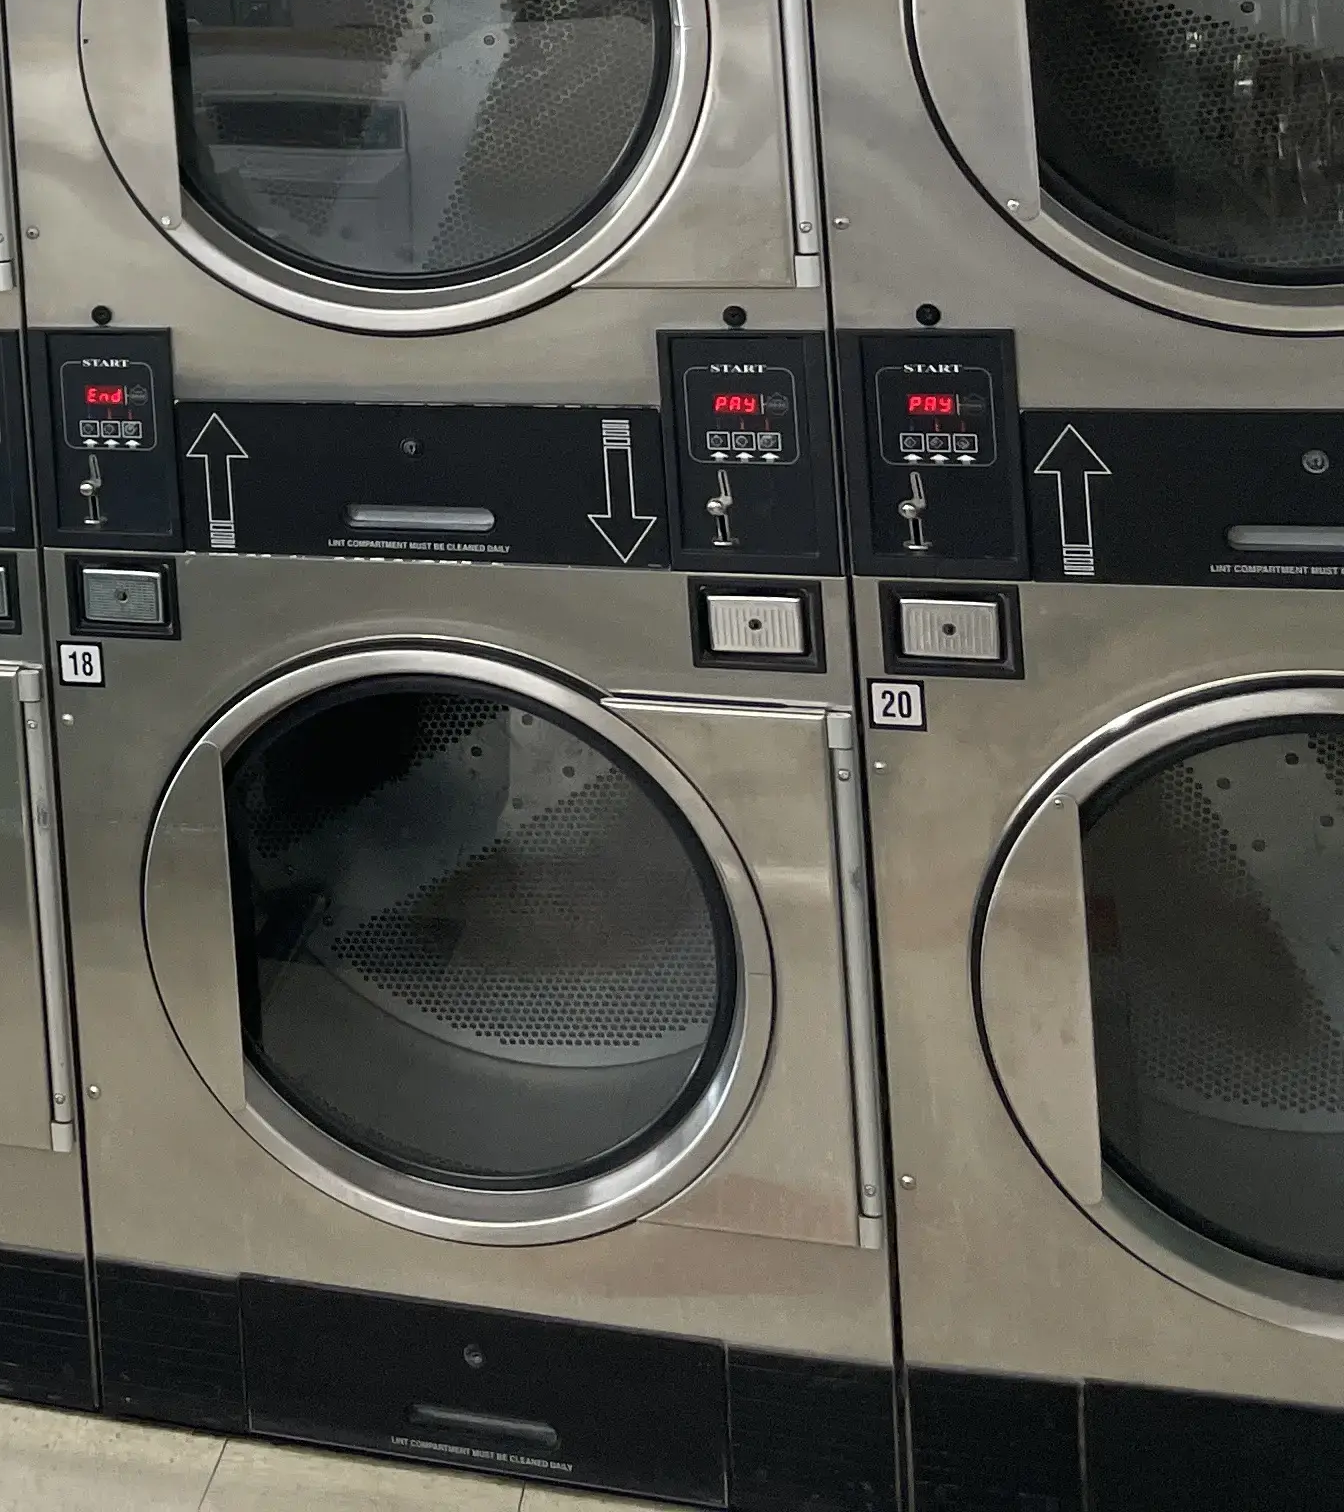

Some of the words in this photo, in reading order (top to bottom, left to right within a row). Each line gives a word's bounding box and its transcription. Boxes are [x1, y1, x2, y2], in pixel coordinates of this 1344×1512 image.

[82, 359, 129, 368] START
[710, 364, 767, 373] START
[903, 364, 963, 373] START
[87, 388, 122, 403] End
[328, 539, 345, 547] LINT
[347, 539, 407, 549] COMPARTMENT
[409, 542, 432, 550] MUST
[434, 543, 445, 551] BE
[446, 543, 485, 552] CLEANED
[487, 544, 510, 553] DAILY
[1210, 564, 1231, 573] LINT
[1234, 564, 1309, 575] COMPARTMENT
[1311, 566, 1338, 575] MUST
[69, 651, 94, 677] 18
[880, 690, 912, 719] 20
[410, 1439, 471, 1456] COMPARTMENT
[473, 1449, 495, 1460] MUST
[496, 1452, 508, 1462] BE
[510, 1454, 549, 1468] CLEANED
[550, 1461, 573, 1472] DAILY
